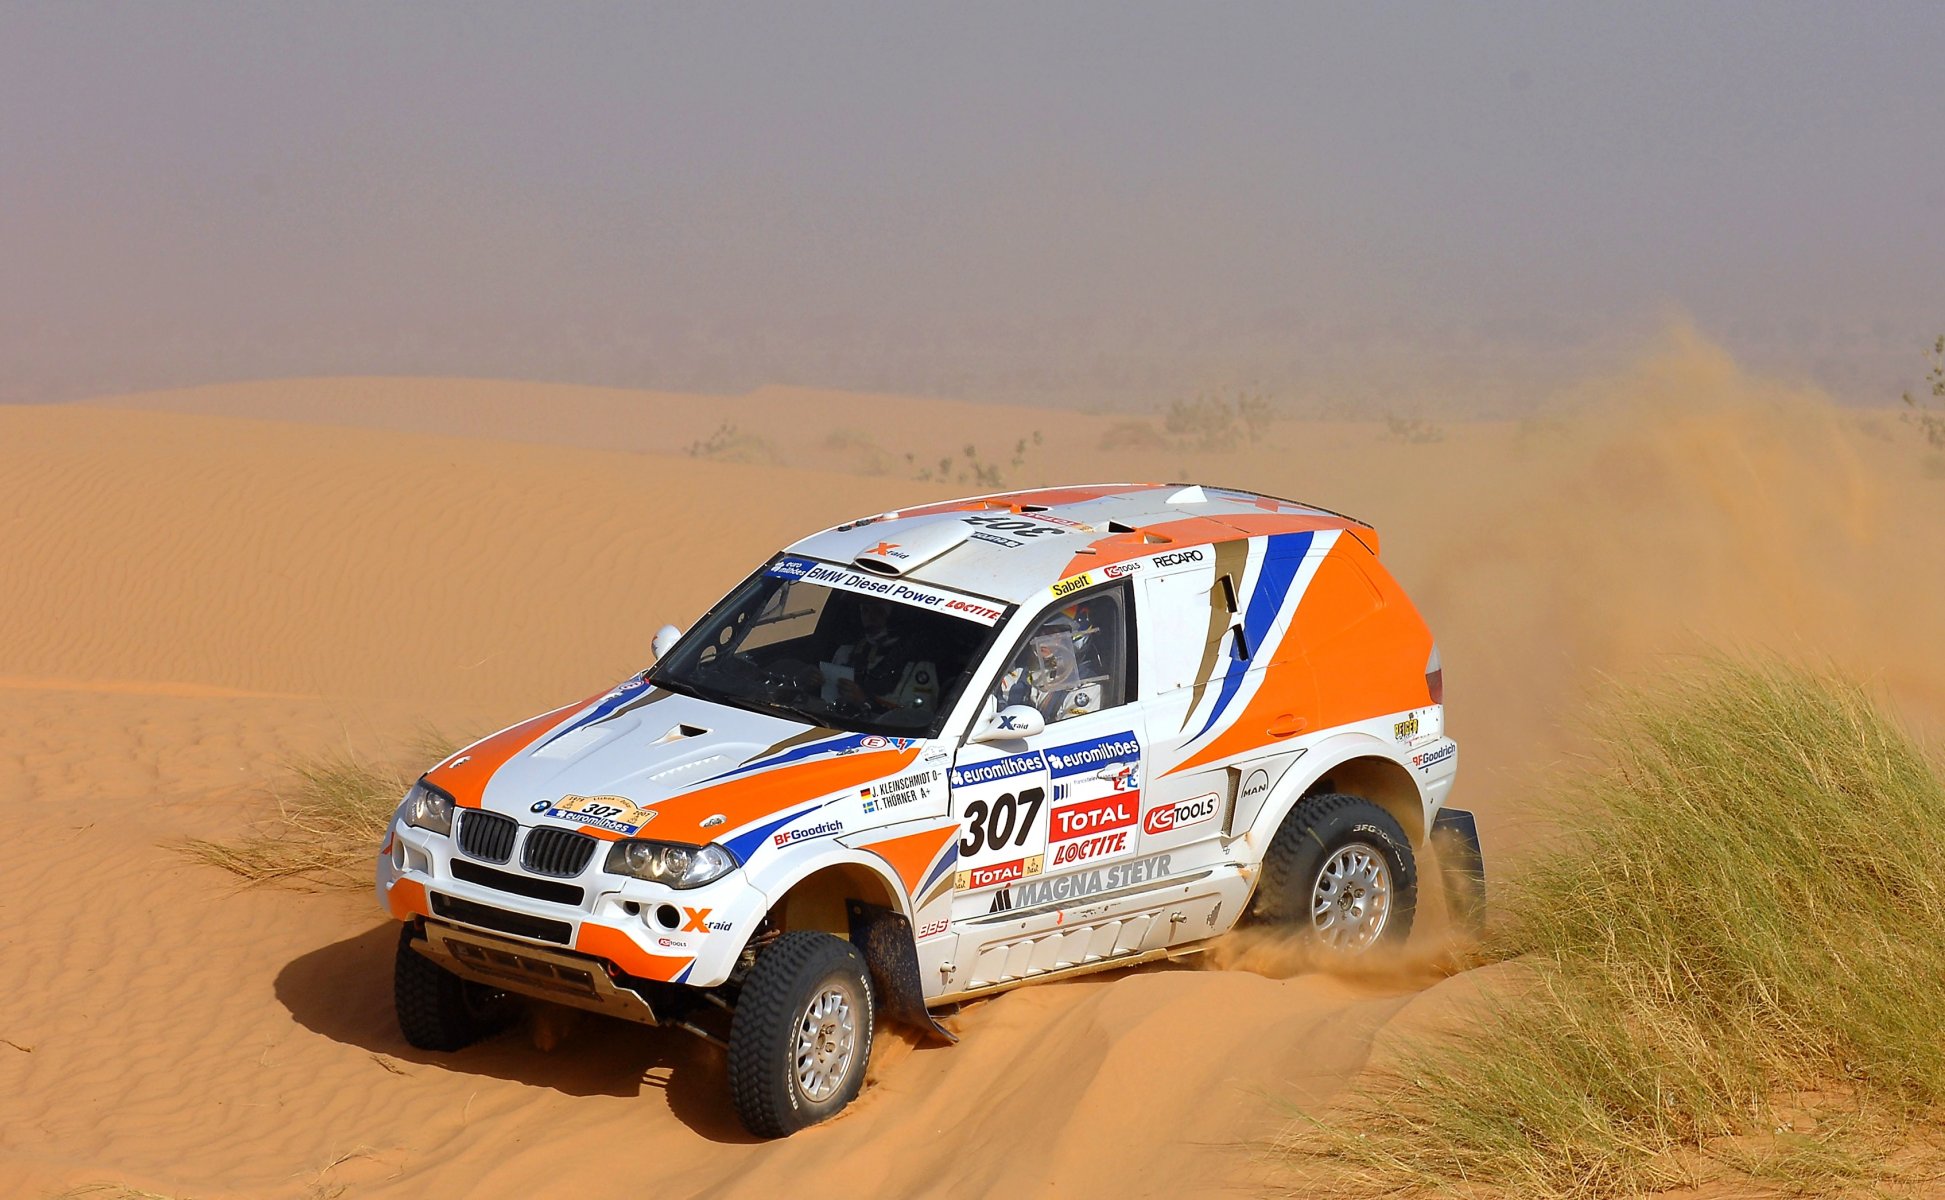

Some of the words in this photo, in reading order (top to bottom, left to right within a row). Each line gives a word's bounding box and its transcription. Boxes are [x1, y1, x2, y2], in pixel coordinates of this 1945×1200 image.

[785, 561, 803, 569] euro
[1152, 549, 1203, 569] RECARO
[807, 567, 849, 584] BMW
[843, 574, 896, 595] Diesel
[891, 584, 945, 607] Power
[1052, 574, 1091, 597] Sabelt
[1412, 743, 1456, 767] BFGoodrich
[871, 785, 879, 798] J.
[878, 771, 931, 793] KLEINSCHMIDT
[1243, 783, 1268, 798] MAN
[873, 799, 883, 812] T.
[881, 789, 918, 810] THÖRNER
[920, 786, 931, 798] A+
[582, 803, 623, 821] 307
[958, 786, 1046, 858] 307
[1057, 803, 1132, 834] TOTAL
[773, 819, 844, 846] BFGoodrich
[972, 865, 1022, 886] TOTAL
[1014, 871, 1103, 908] MAGNA
[1105, 853, 1173, 889] STEYR
[680, 906, 733, 934] X-raid
[918, 918, 949, 939] BBS
